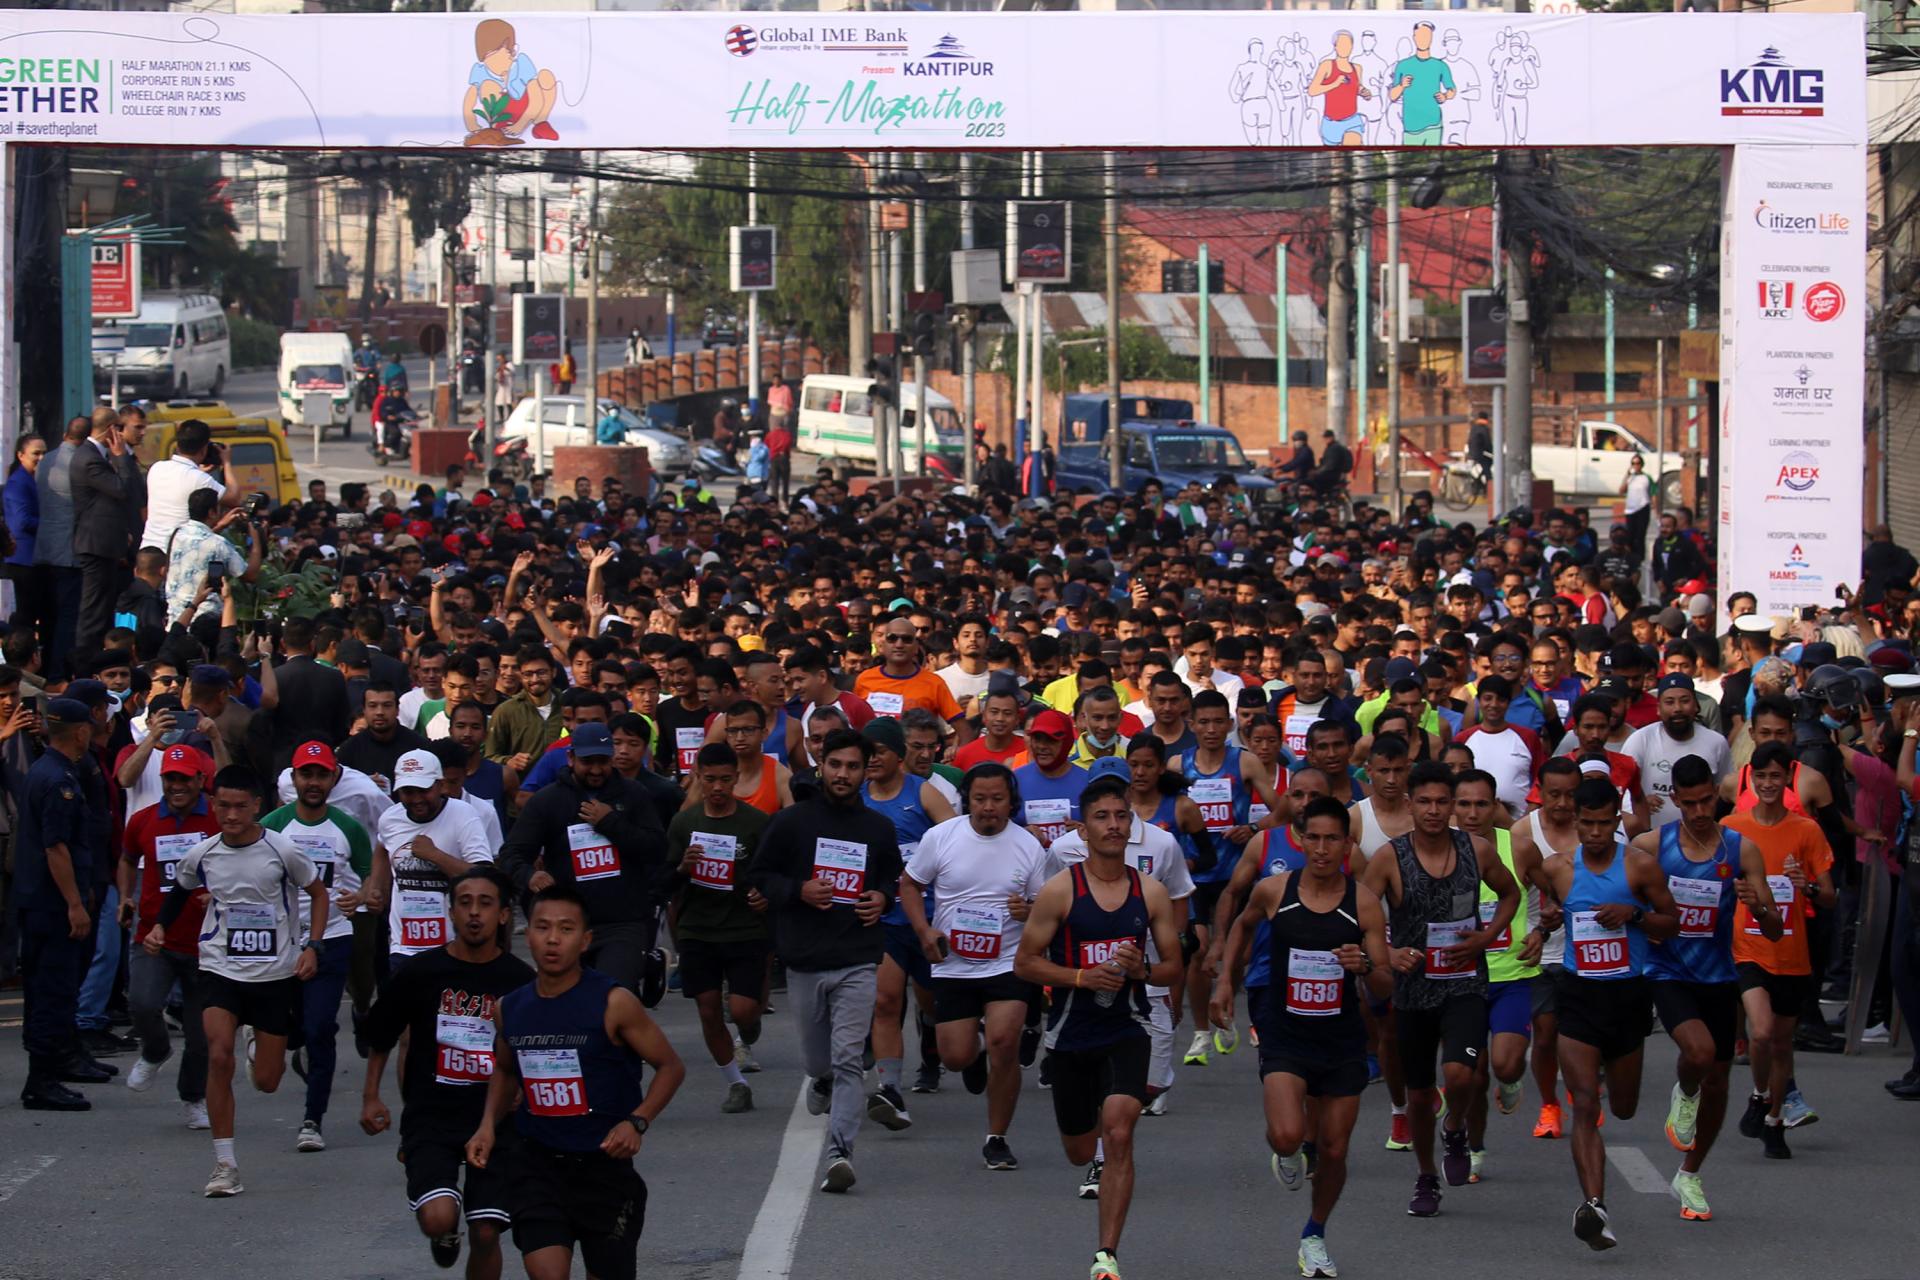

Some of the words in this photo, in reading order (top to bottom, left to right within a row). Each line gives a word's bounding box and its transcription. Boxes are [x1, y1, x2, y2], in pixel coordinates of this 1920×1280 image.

[760, 27, 813, 42] Global
[822, 28, 858, 41] IME
[865, 27, 908, 41] Bank
[0, 58, 99, 83] GREEN
[122, 61, 146, 70] HALF
[149, 61, 202, 71] MARATHON
[205, 62, 225, 71] 21.1
[229, 62, 251, 71] KMS
[904, 62, 994, 76] KANTIPUR
[122, 75, 178, 86] CORPORATE
[181, 77, 201, 86] RUN
[204, 77, 210, 86] 5
[213, 77, 235, 86] KMS
[1720, 69, 1824, 103] KMG
[122, 90, 184, 101] WHEELCHAIR
[187, 91, 212, 101] RACE
[215, 92, 221, 101] 3
[224, 92, 246, 101] KMS
[122, 105, 164, 115] COLLEGE
[168, 106, 187, 115] RUN
[191, 106, 197, 115] 7
[200, 106, 221, 116] KMS
[16, 121, 98, 137] #savetheplanet
[965, 122, 1005, 138] 2023
[1755, 201, 1816, 229] Citizen
[1819, 213, 1850, 229] Life
[1764, 309, 1788, 317] KFC
[1774, 387, 1810, 399] गमला
[1814, 388, 1834, 400] घर
[1776, 465, 1820, 486] APEX
[1769, 571, 1797, 580] HAMS
[1200, 804, 1229, 822] 640
[577, 847, 615, 870] 1914
[1679, 907, 1711, 927] 734
[405, 919, 441, 940] 1913
[230, 930, 272, 952] 490
[955, 933, 996, 954] 1527
[1084, 940, 1132, 965] 164
[1579, 941, 1622, 963] 1510
[1291, 981, 1339, 1003] 1638
[442, 1047, 494, 1076] 1555
[530, 1081, 582, 1107] 1581
